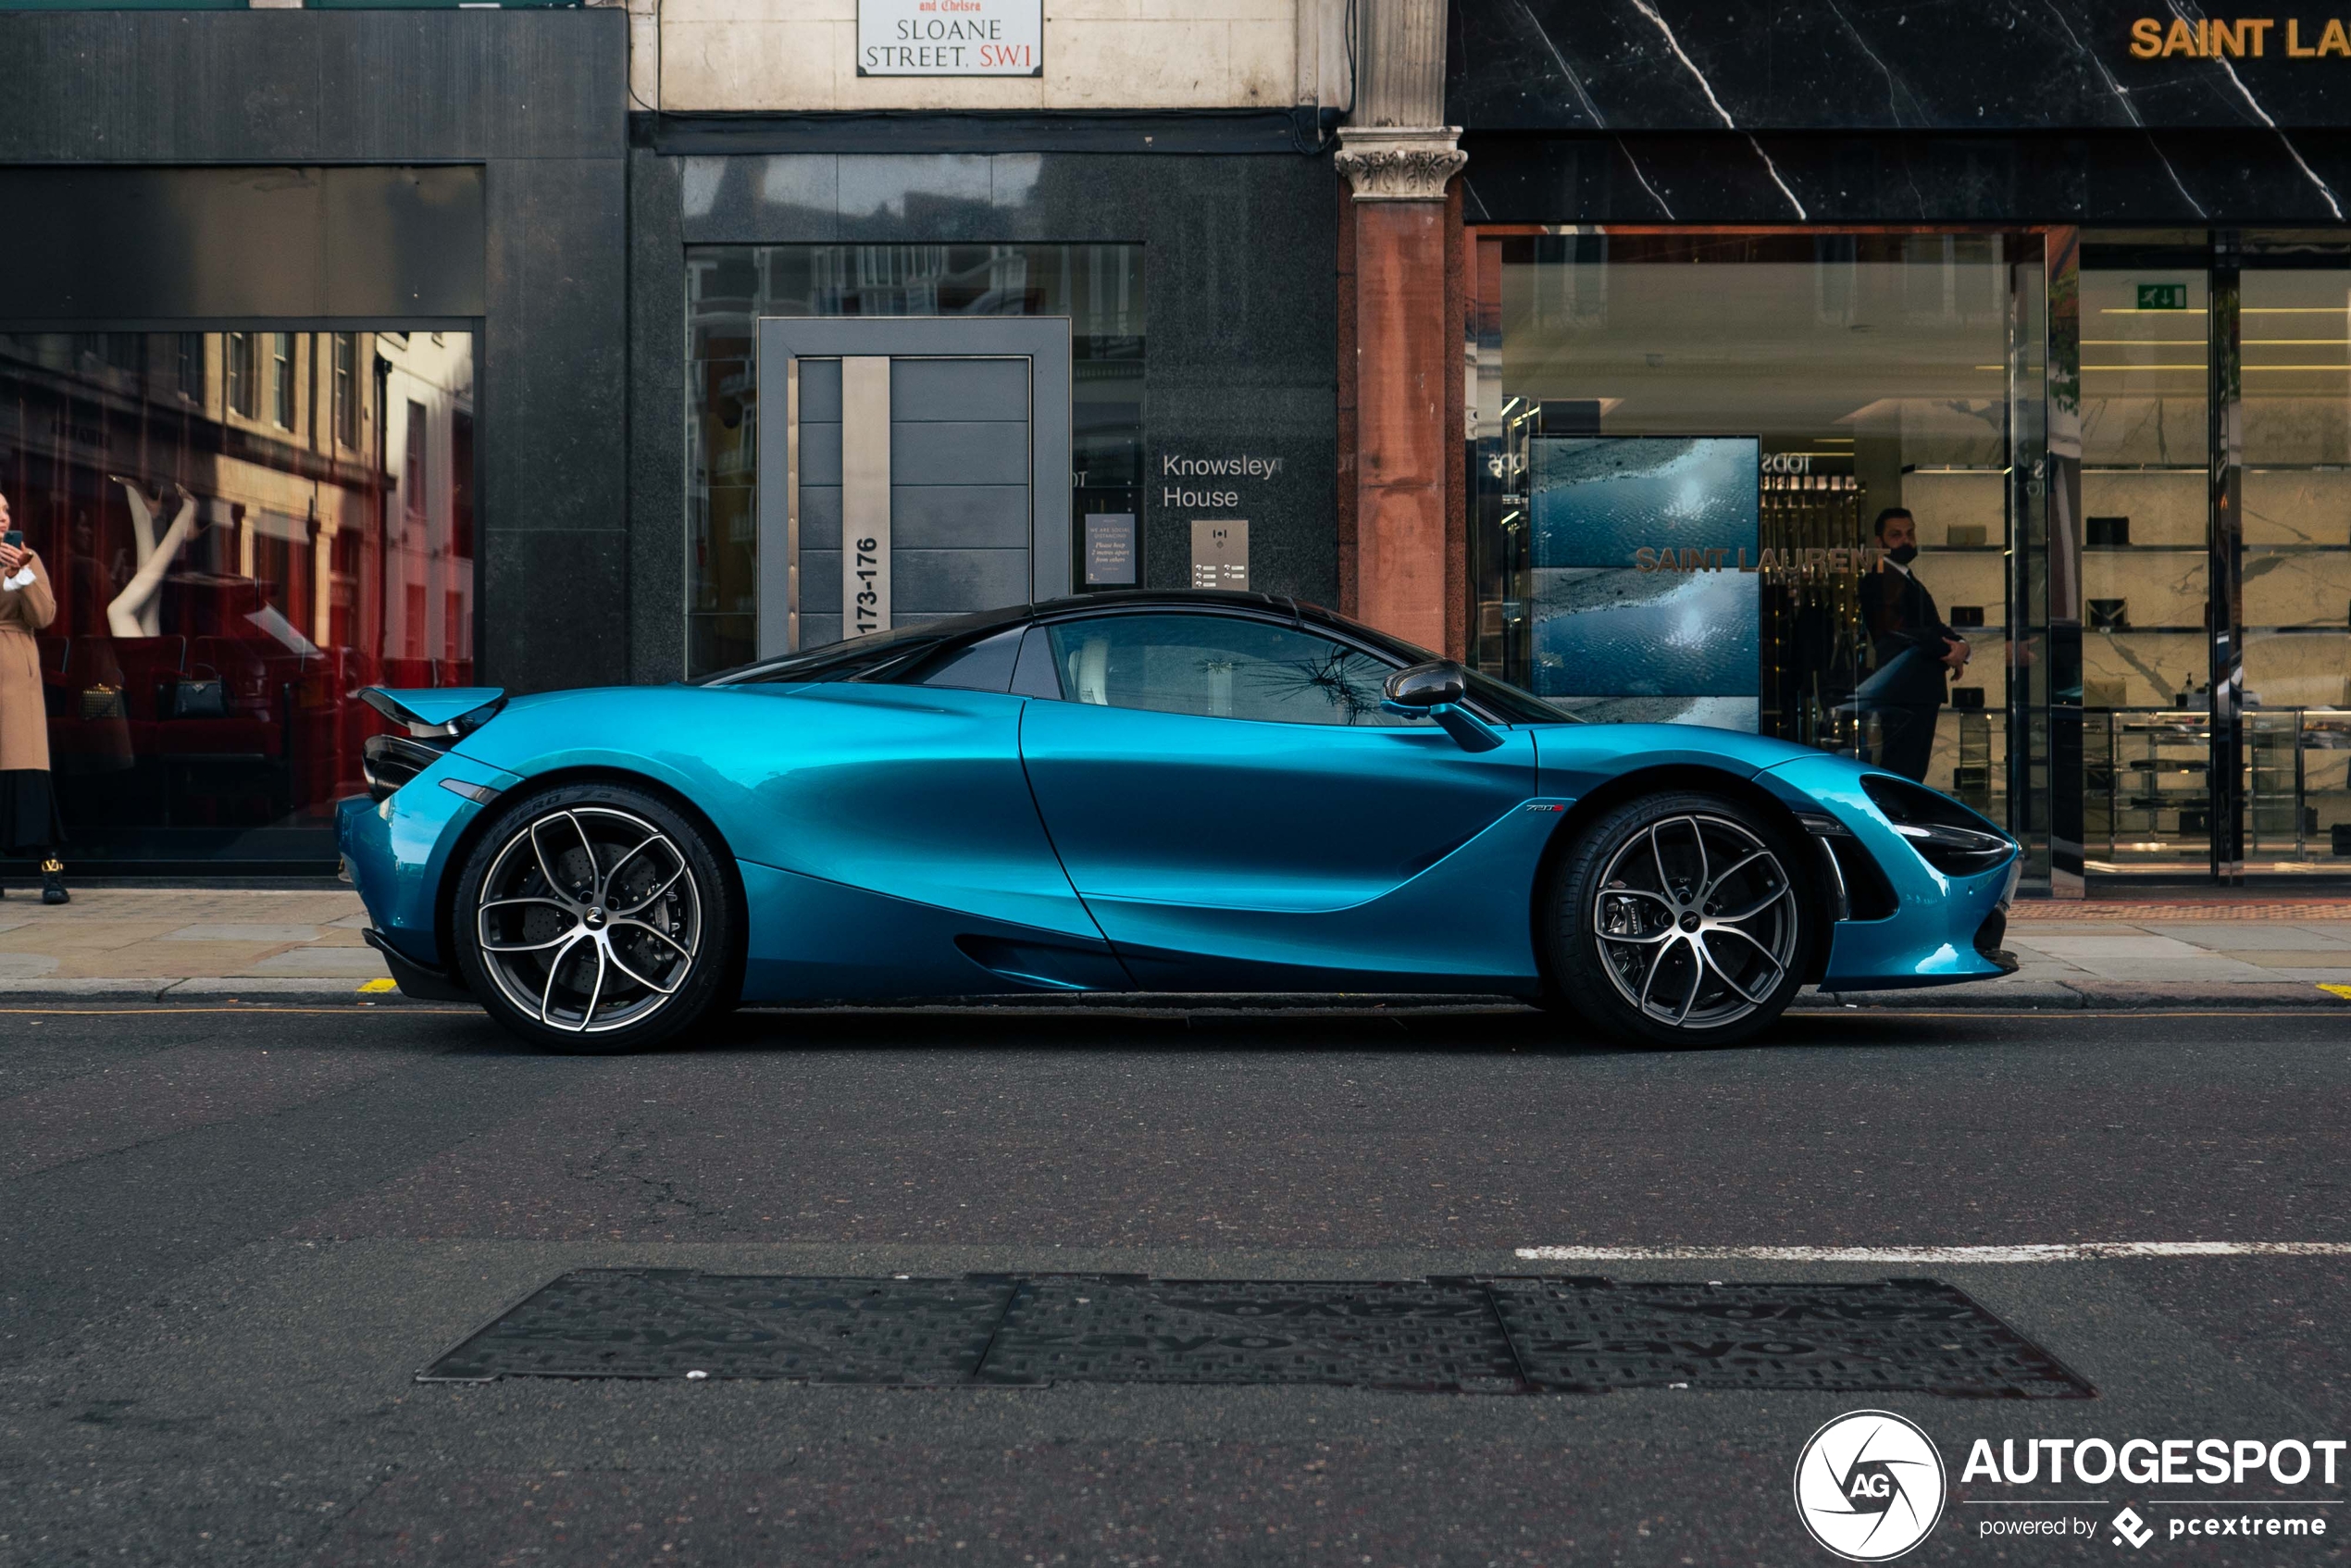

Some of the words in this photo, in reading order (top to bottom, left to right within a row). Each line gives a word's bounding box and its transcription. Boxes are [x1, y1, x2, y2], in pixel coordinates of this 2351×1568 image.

[897, 19, 1001, 40] SLOANE
[2130, 18, 2274, 58] SAINT
[2285, 18, 2351, 58] LA
[1163, 454, 1276, 479] Knowsley
[1163, 486, 1238, 507] House
[1636, 547, 1729, 573] SAINT
[1738, 547, 1891, 574] LAURENT
[856, 538, 877, 633] 173-176
[1630, 907, 1639, 935] Laren
